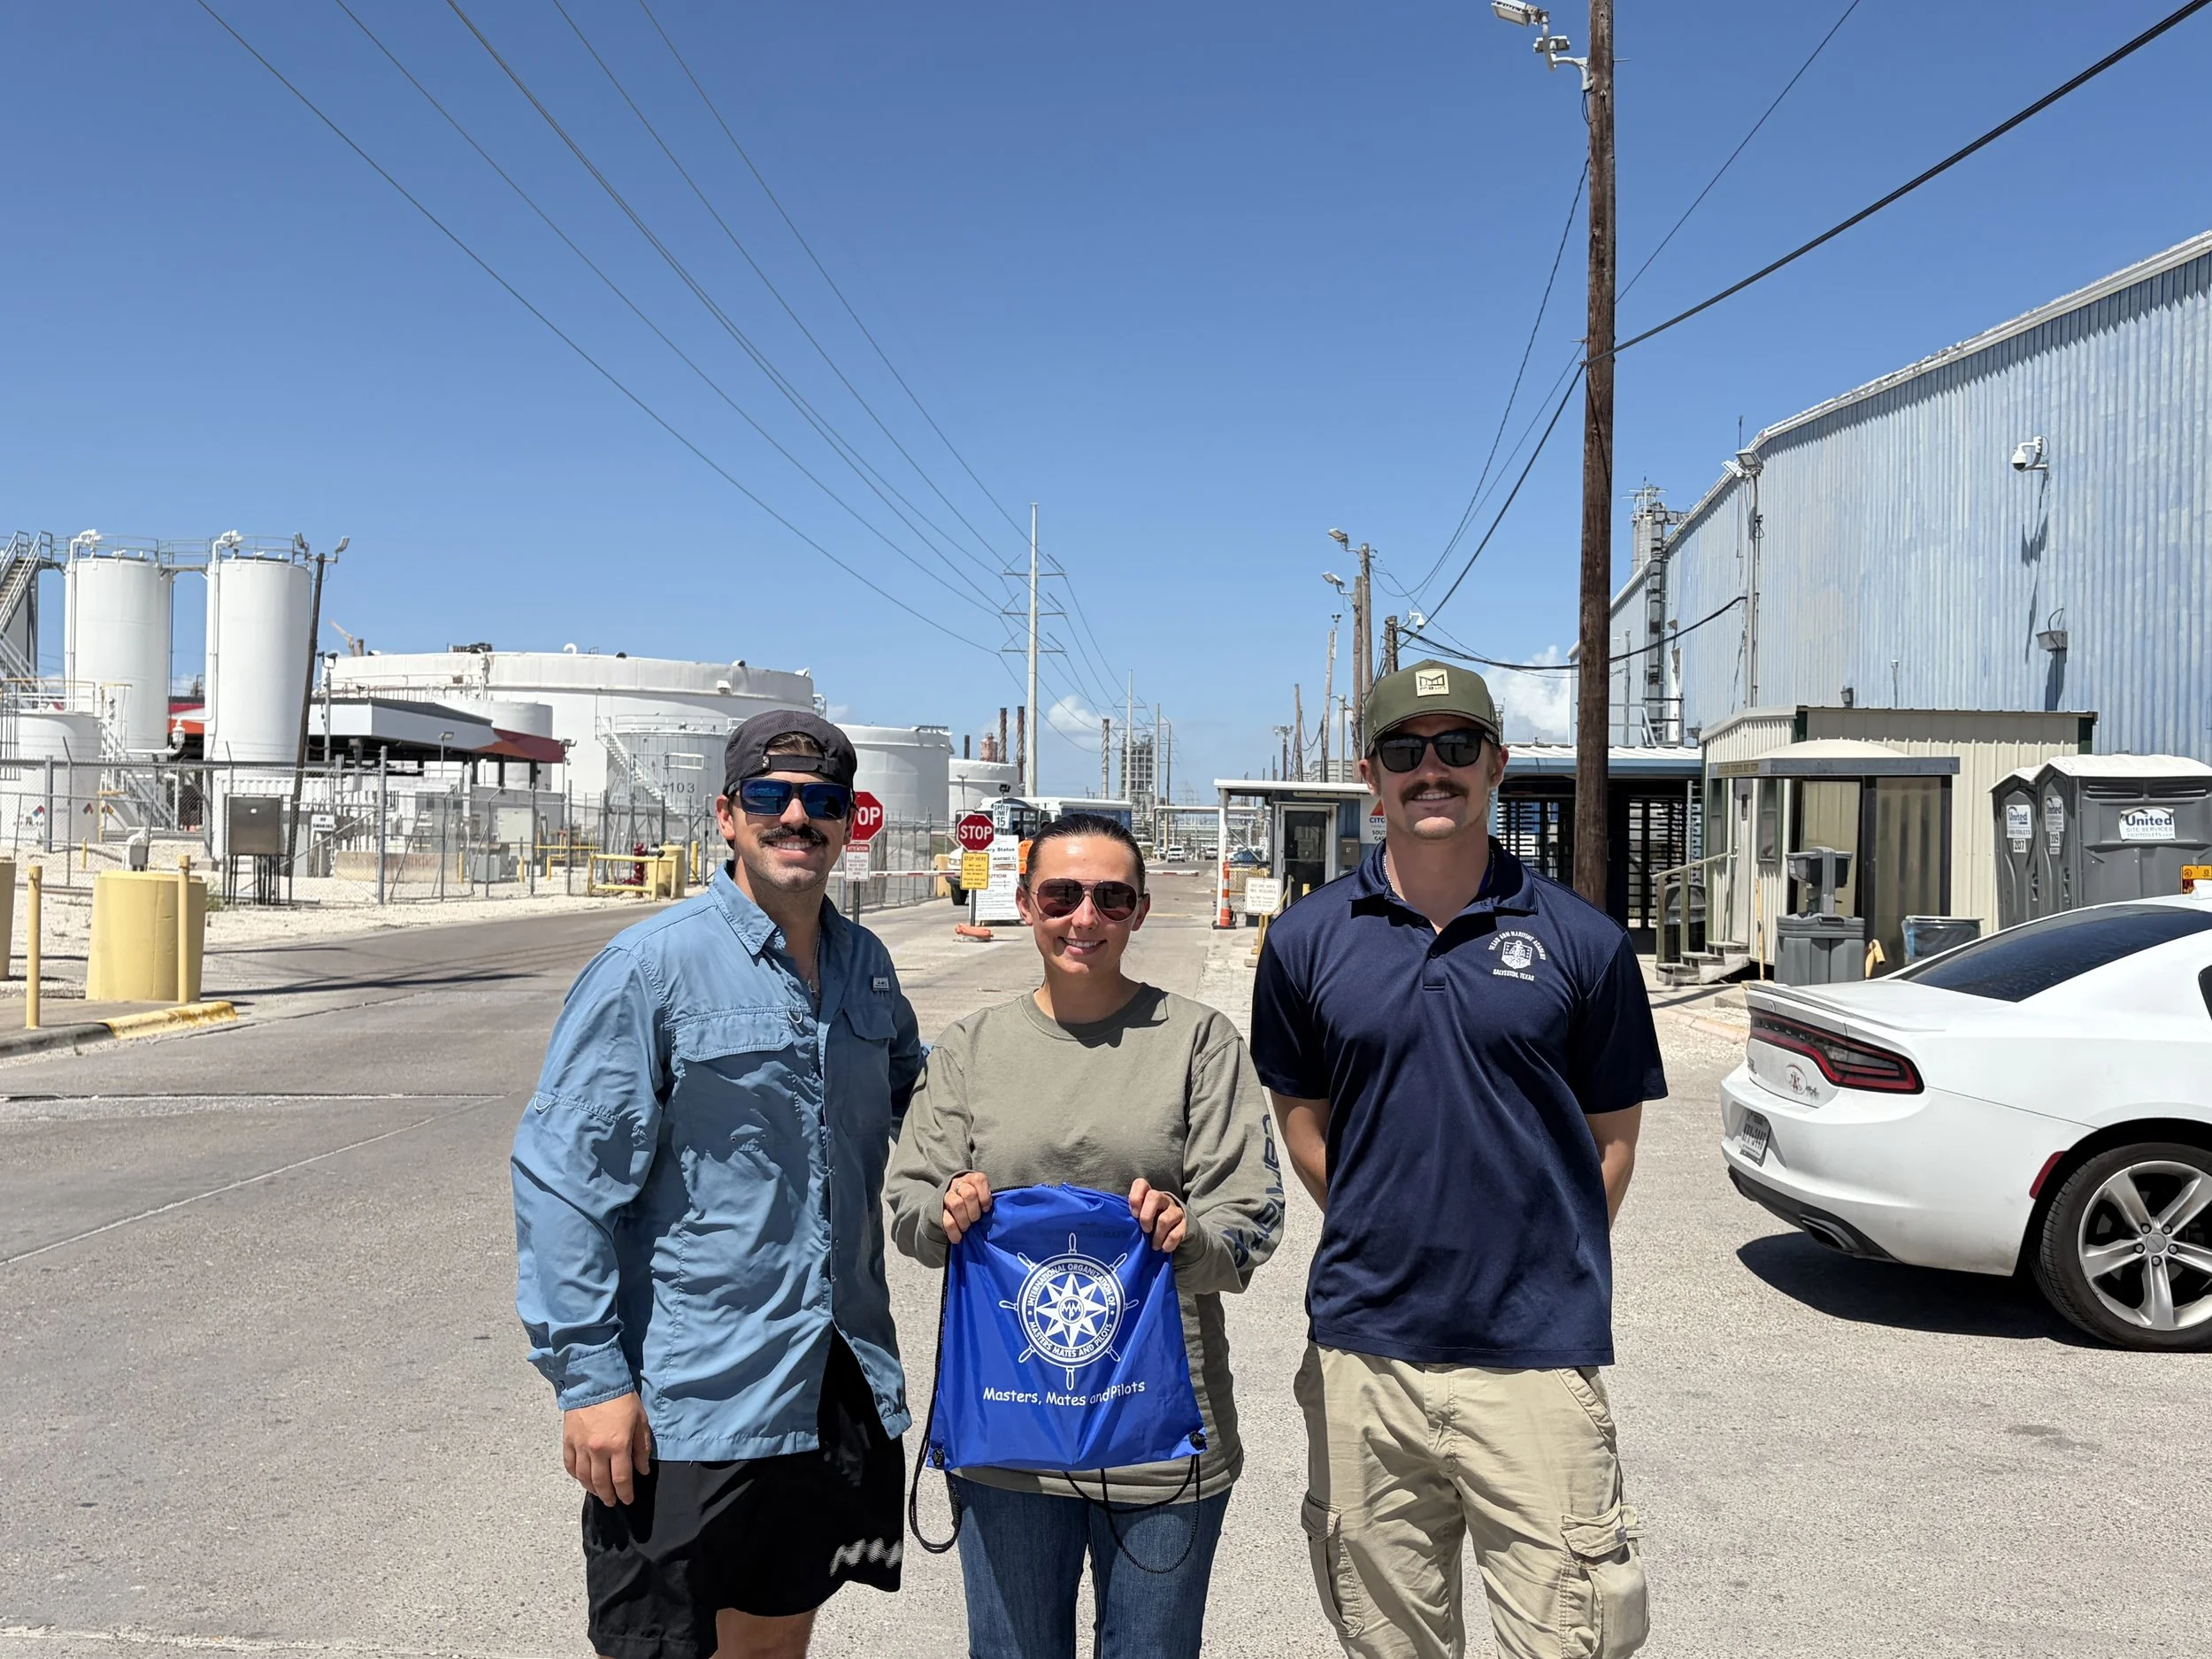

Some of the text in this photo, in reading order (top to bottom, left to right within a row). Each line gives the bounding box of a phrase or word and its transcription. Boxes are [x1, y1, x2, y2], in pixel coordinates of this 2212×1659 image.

[857, 806, 880, 826] OP
[996, 816, 1006, 826] 15
[2008, 810, 2028, 821] United
[2125, 814, 2172, 826] United
[960, 826, 992, 840] STOP
[2014, 840, 2024, 849] 207
[1510, 931, 1535, 942] MARITIME
[1532, 940, 1547, 961] ACADEMY
[1519, 972, 1535, 982] TEXAS
[1027, 1263, 1116, 1306] INTERNATIONAL ORGANIZATION OF
[1028, 1321, 1112, 1357] MASTERS MATES AND PILOTS
[983, 1386, 1042, 1405] Masters,
[1046, 1391, 1086, 1406] Mates
